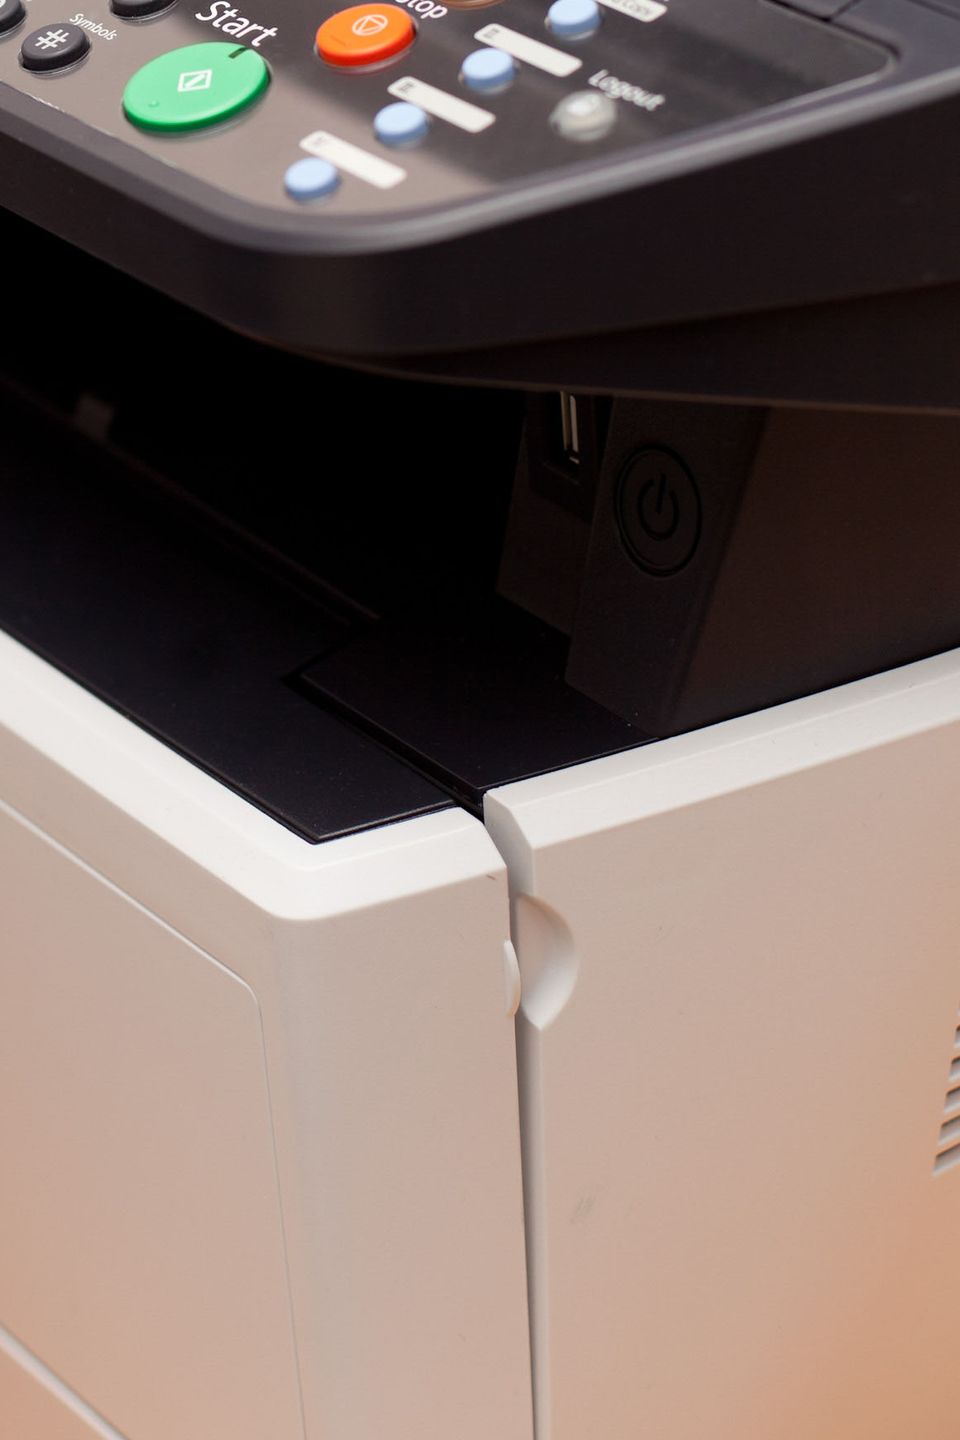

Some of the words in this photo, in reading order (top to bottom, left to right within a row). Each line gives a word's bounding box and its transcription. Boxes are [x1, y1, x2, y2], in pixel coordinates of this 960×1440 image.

[34, 29, 70, 50] #
[69, 13, 118, 41] Symbols
[195, 0, 278, 47] Start
[588, 69, 666, 112] Logout
